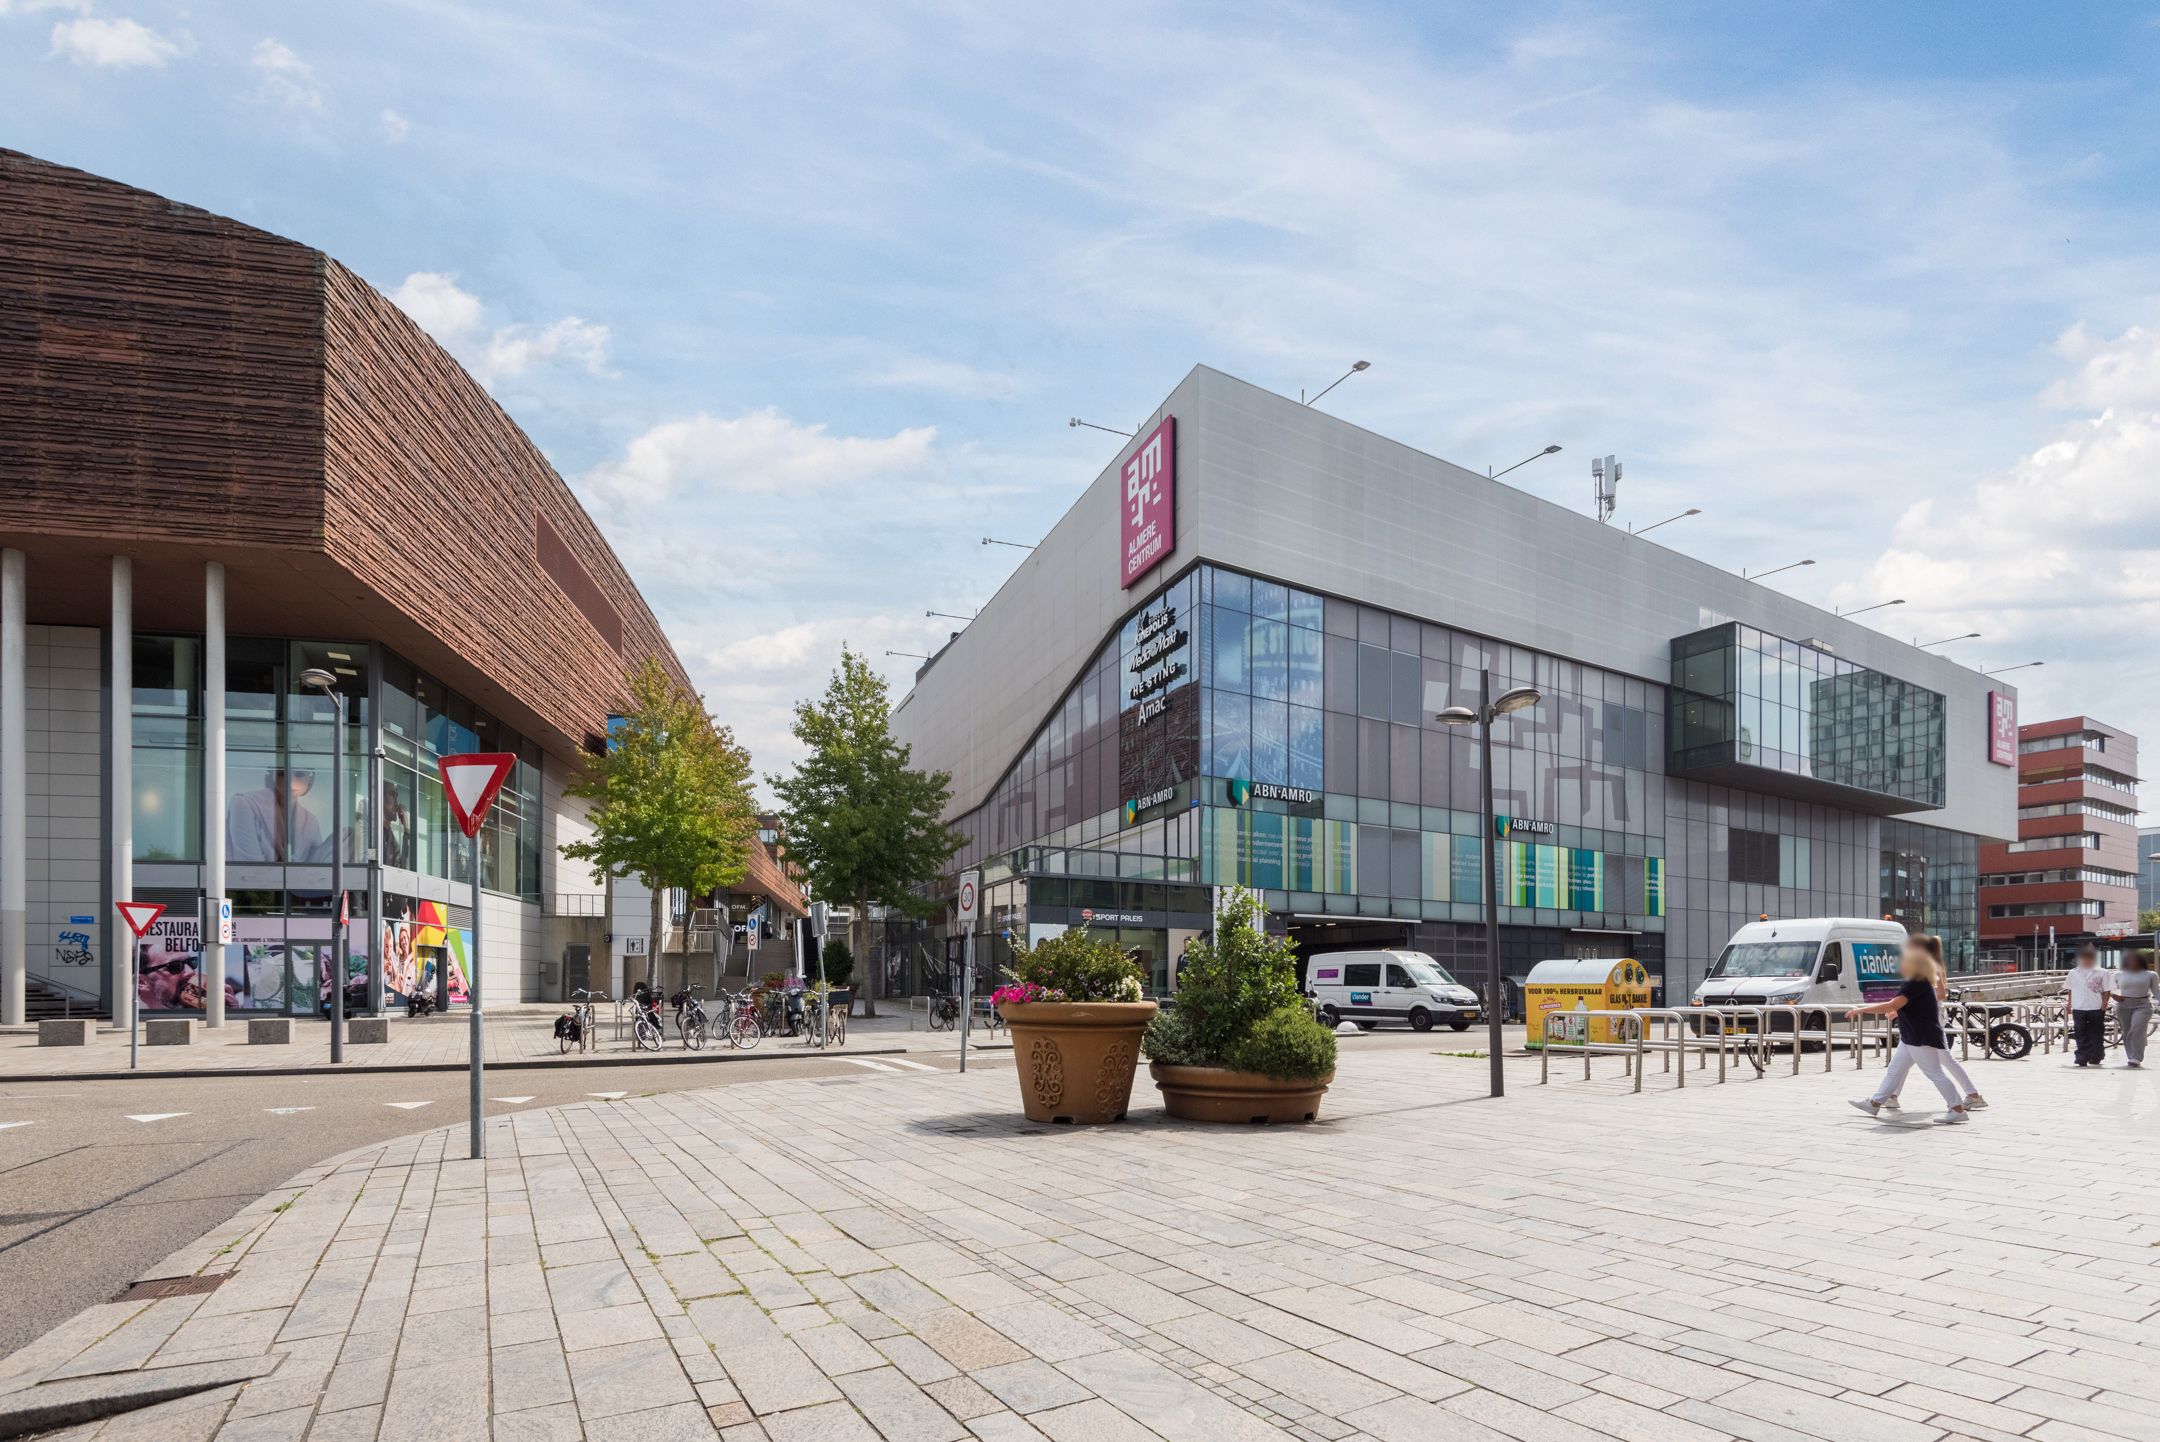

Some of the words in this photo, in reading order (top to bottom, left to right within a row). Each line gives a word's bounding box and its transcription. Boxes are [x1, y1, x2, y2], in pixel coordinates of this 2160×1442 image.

[1128, 519, 1156, 558] ALMERE
[1128, 534, 1162, 574] CENTRUM
[1135, 613, 1169, 645] KINEPOLIS
[1128, 681, 1144, 699] THE
[1148, 662, 1176, 687] STING
[1137, 696, 1166, 726] Amac
[963, 891, 972, 903] 30
[1095, 913, 1119, 921] SPORT
[1120, 914, 1143, 922] PALEIS
[1859, 948, 1896, 974] Liande
[1559, 988, 1603, 996] HERBRUIKBAAR
[1609, 993, 1621, 1004] GLAS
